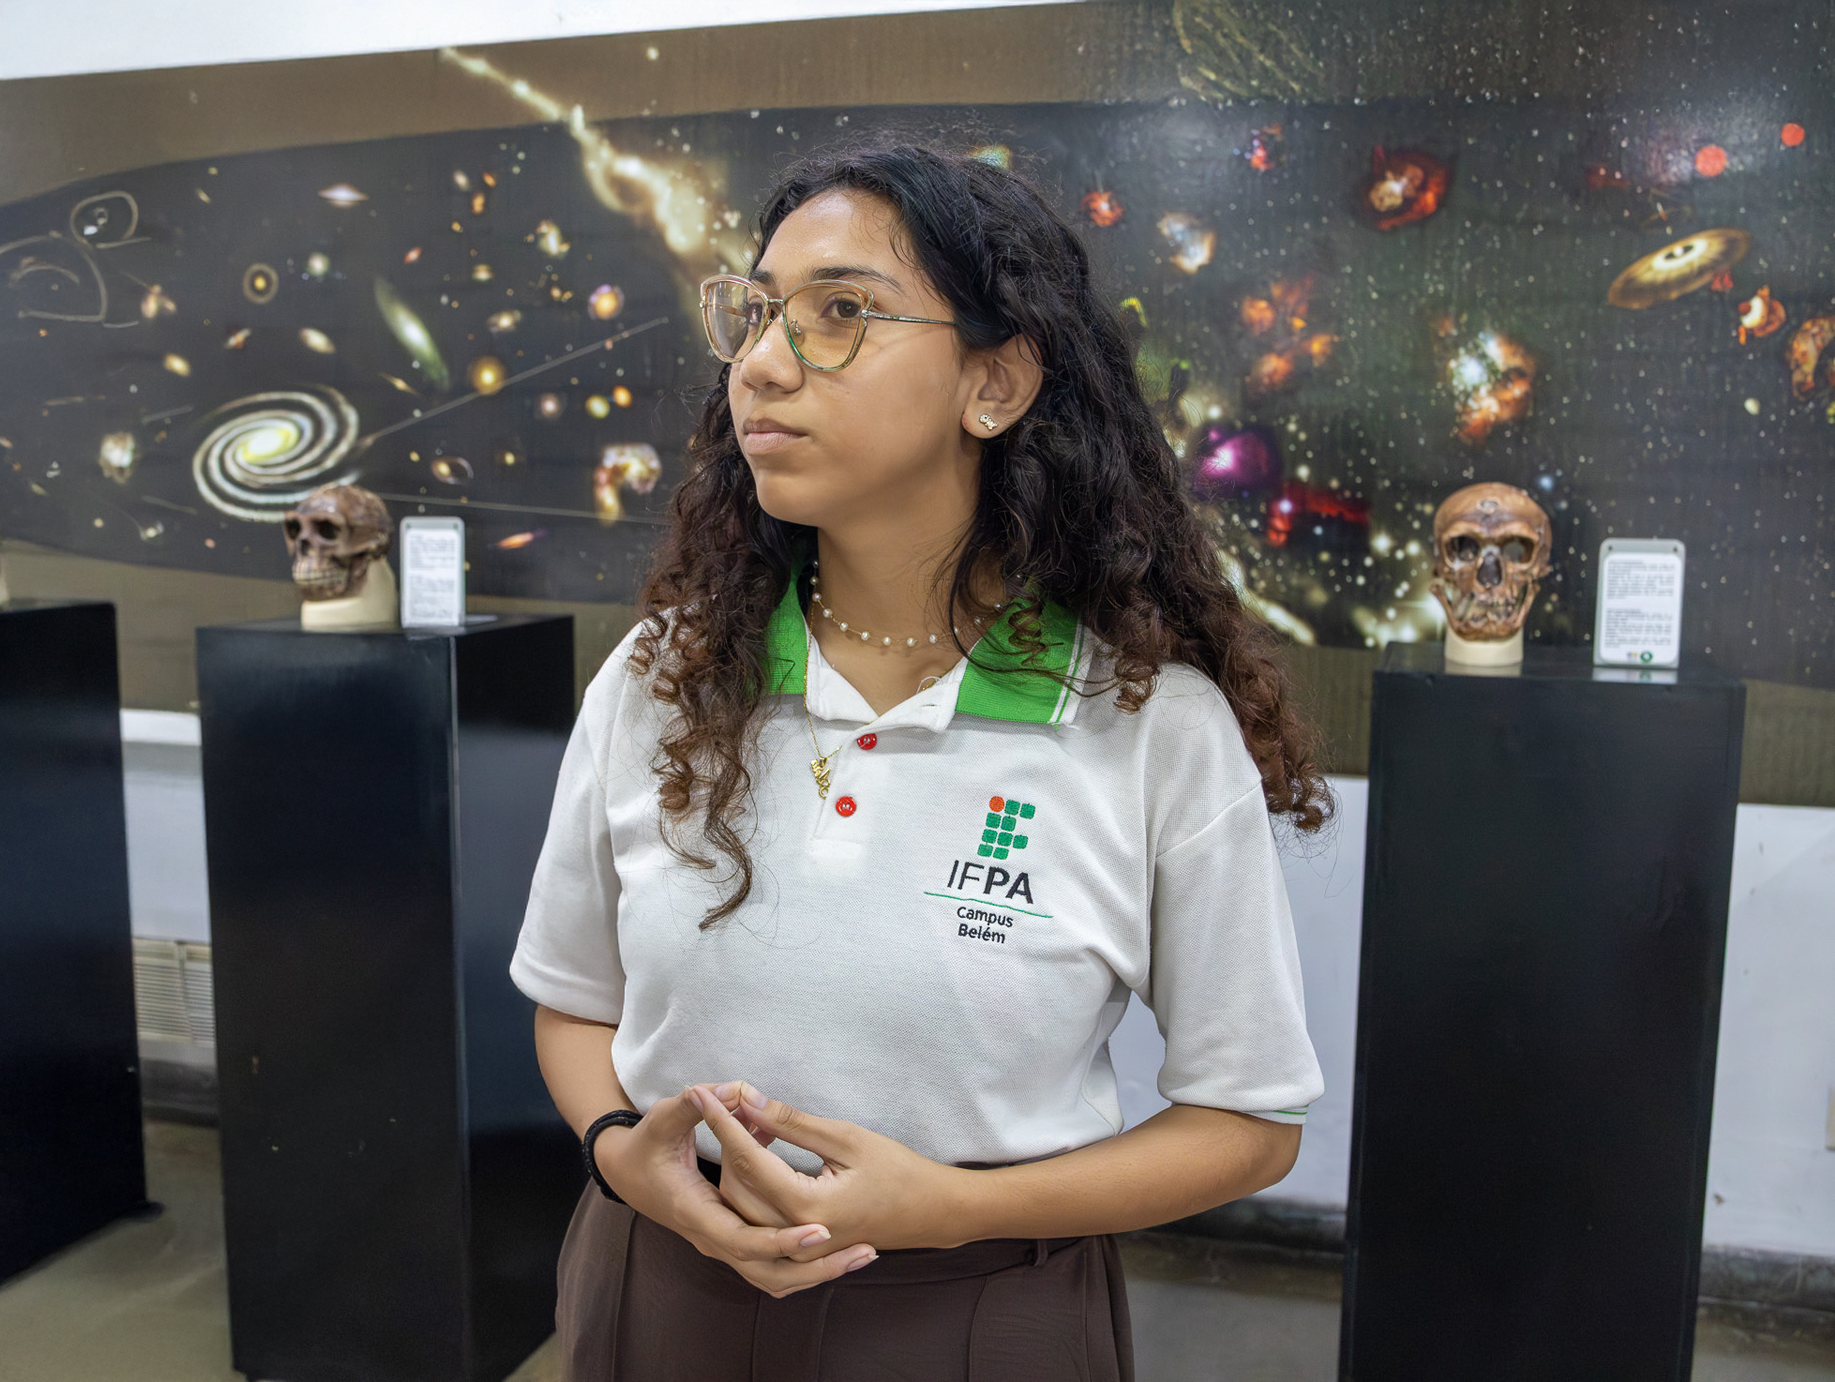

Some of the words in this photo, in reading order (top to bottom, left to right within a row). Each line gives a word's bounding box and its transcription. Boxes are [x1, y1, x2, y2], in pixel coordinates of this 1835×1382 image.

[947, 860, 1034, 904] IFPA
[957, 906, 1014, 928] Campus
[958, 923, 1006, 944] Belém
